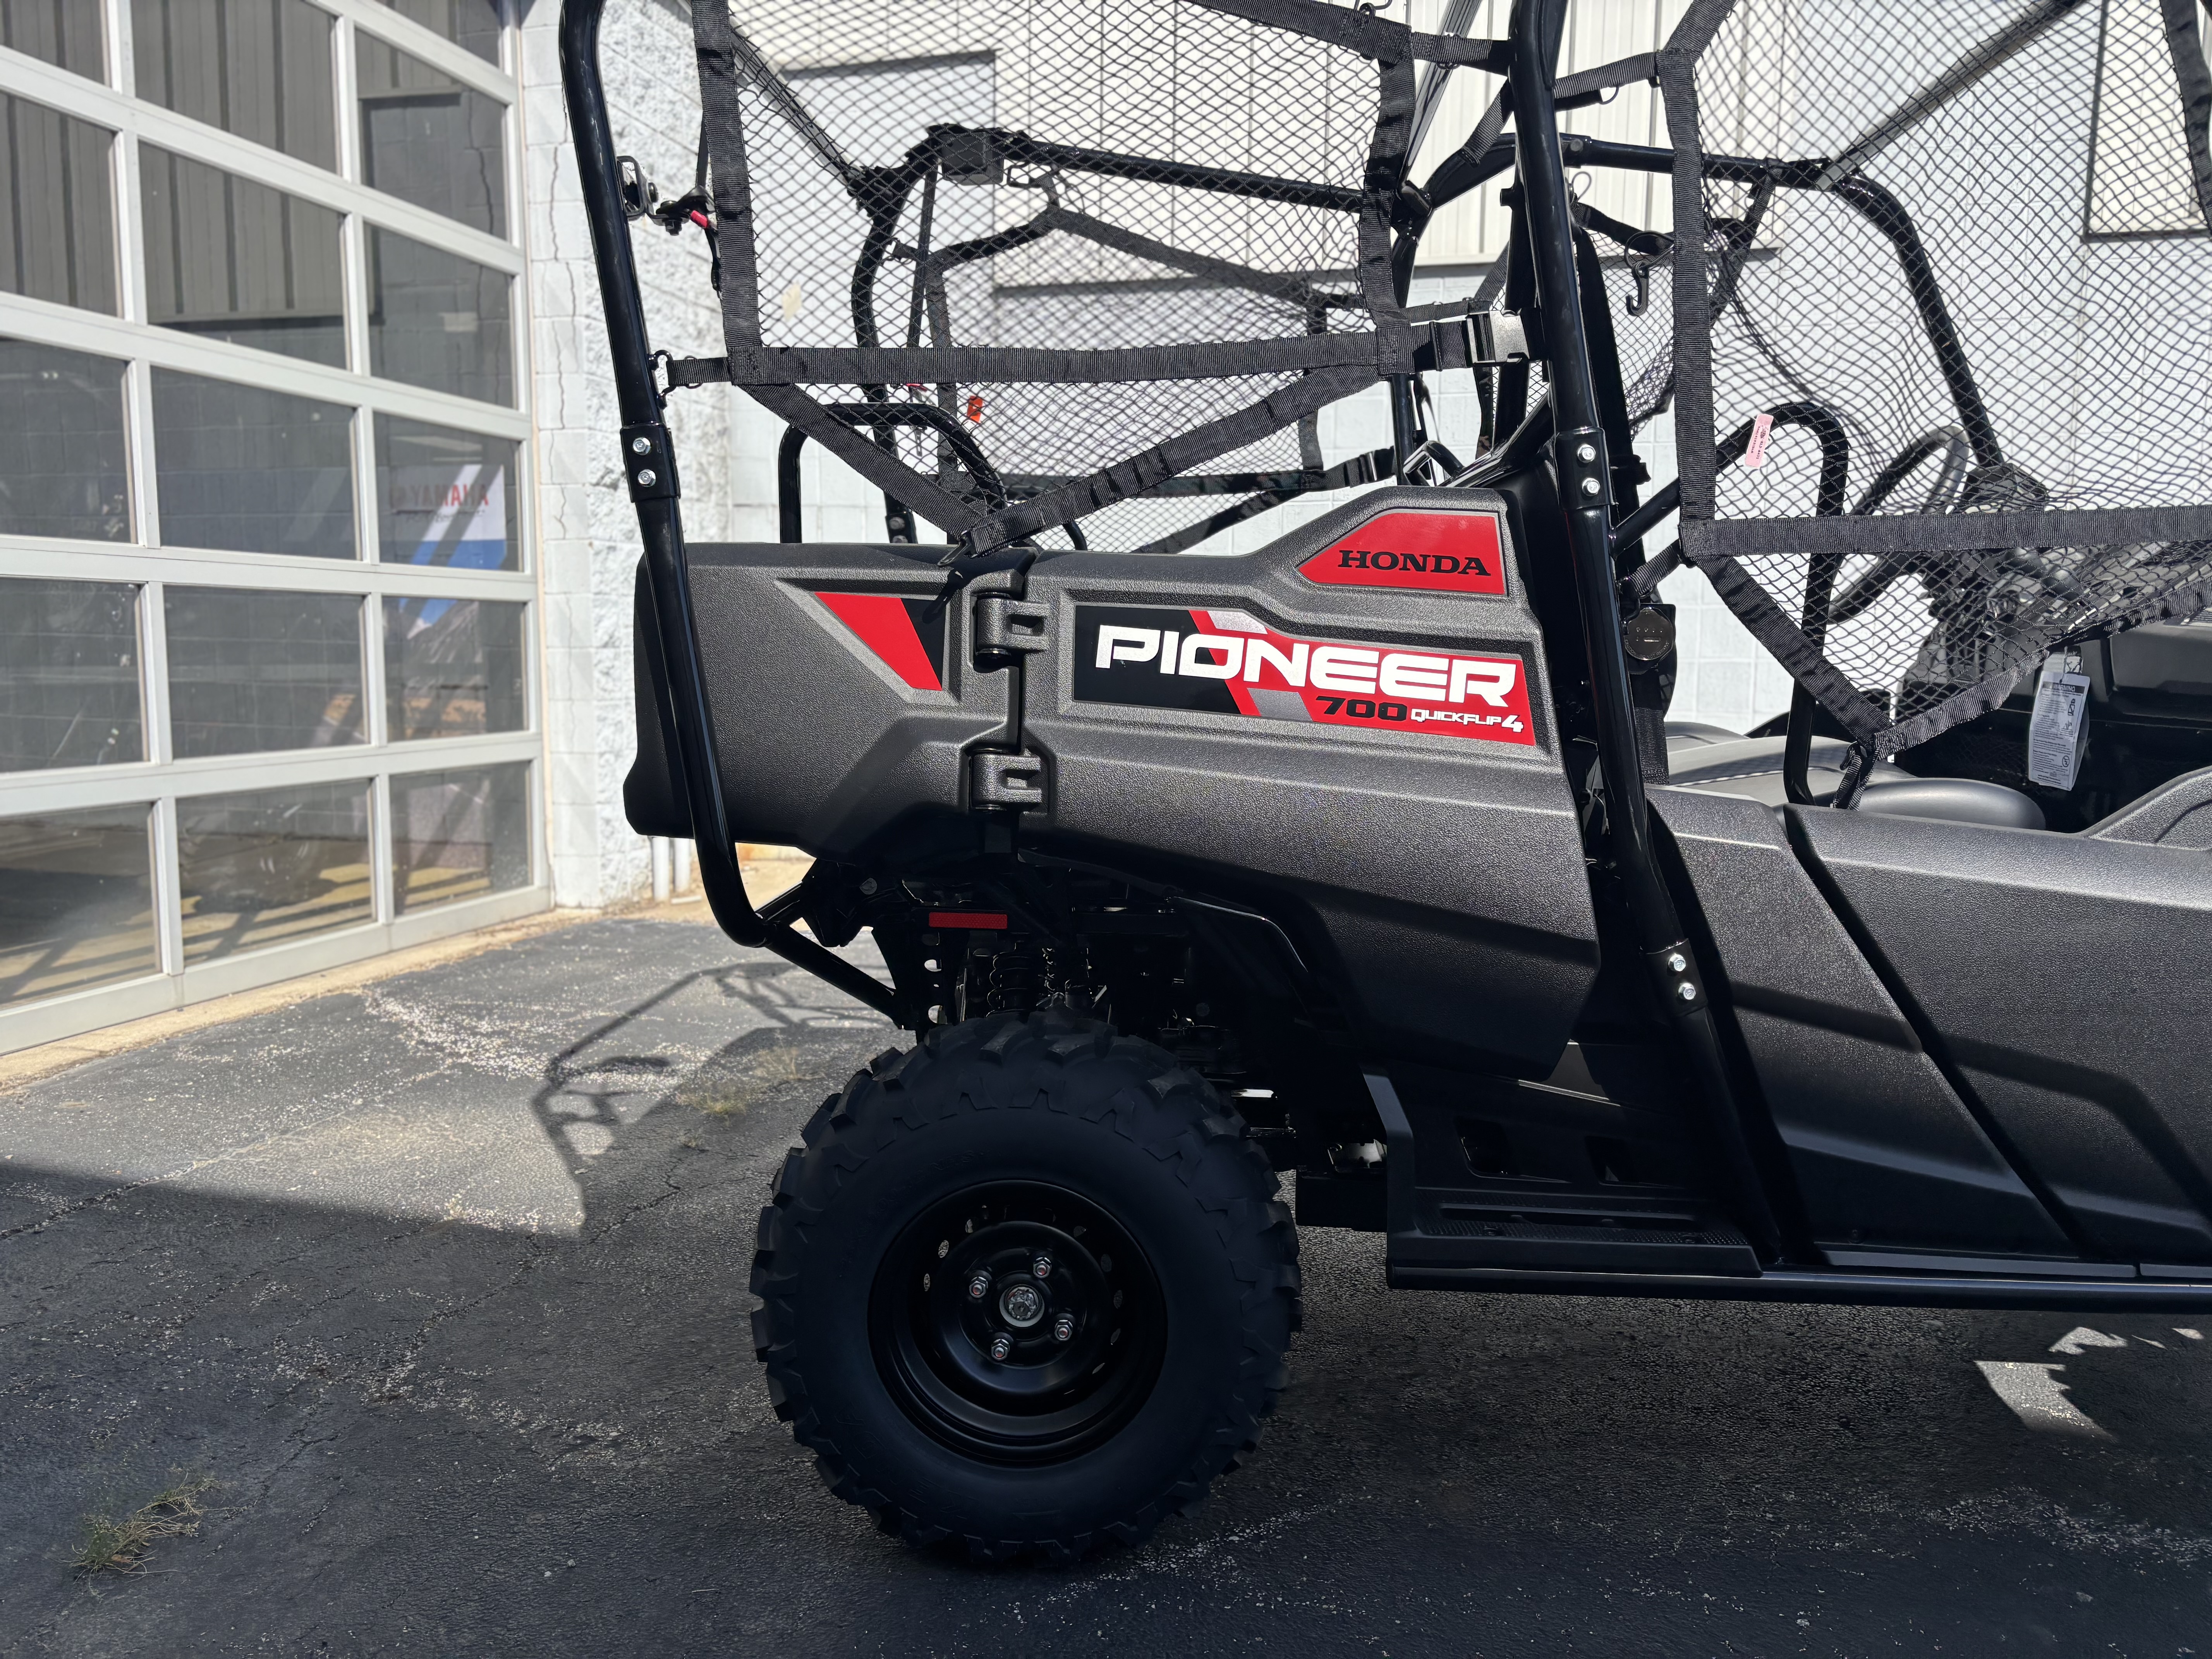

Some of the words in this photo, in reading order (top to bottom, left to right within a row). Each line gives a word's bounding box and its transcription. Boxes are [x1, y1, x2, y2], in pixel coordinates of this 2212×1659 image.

[409, 484, 489, 506] YAMAHA
[1338, 550, 1491, 576] HONDA
[1096, 624, 1516, 708] PIONEER
[1316, 696, 1408, 721] 700
